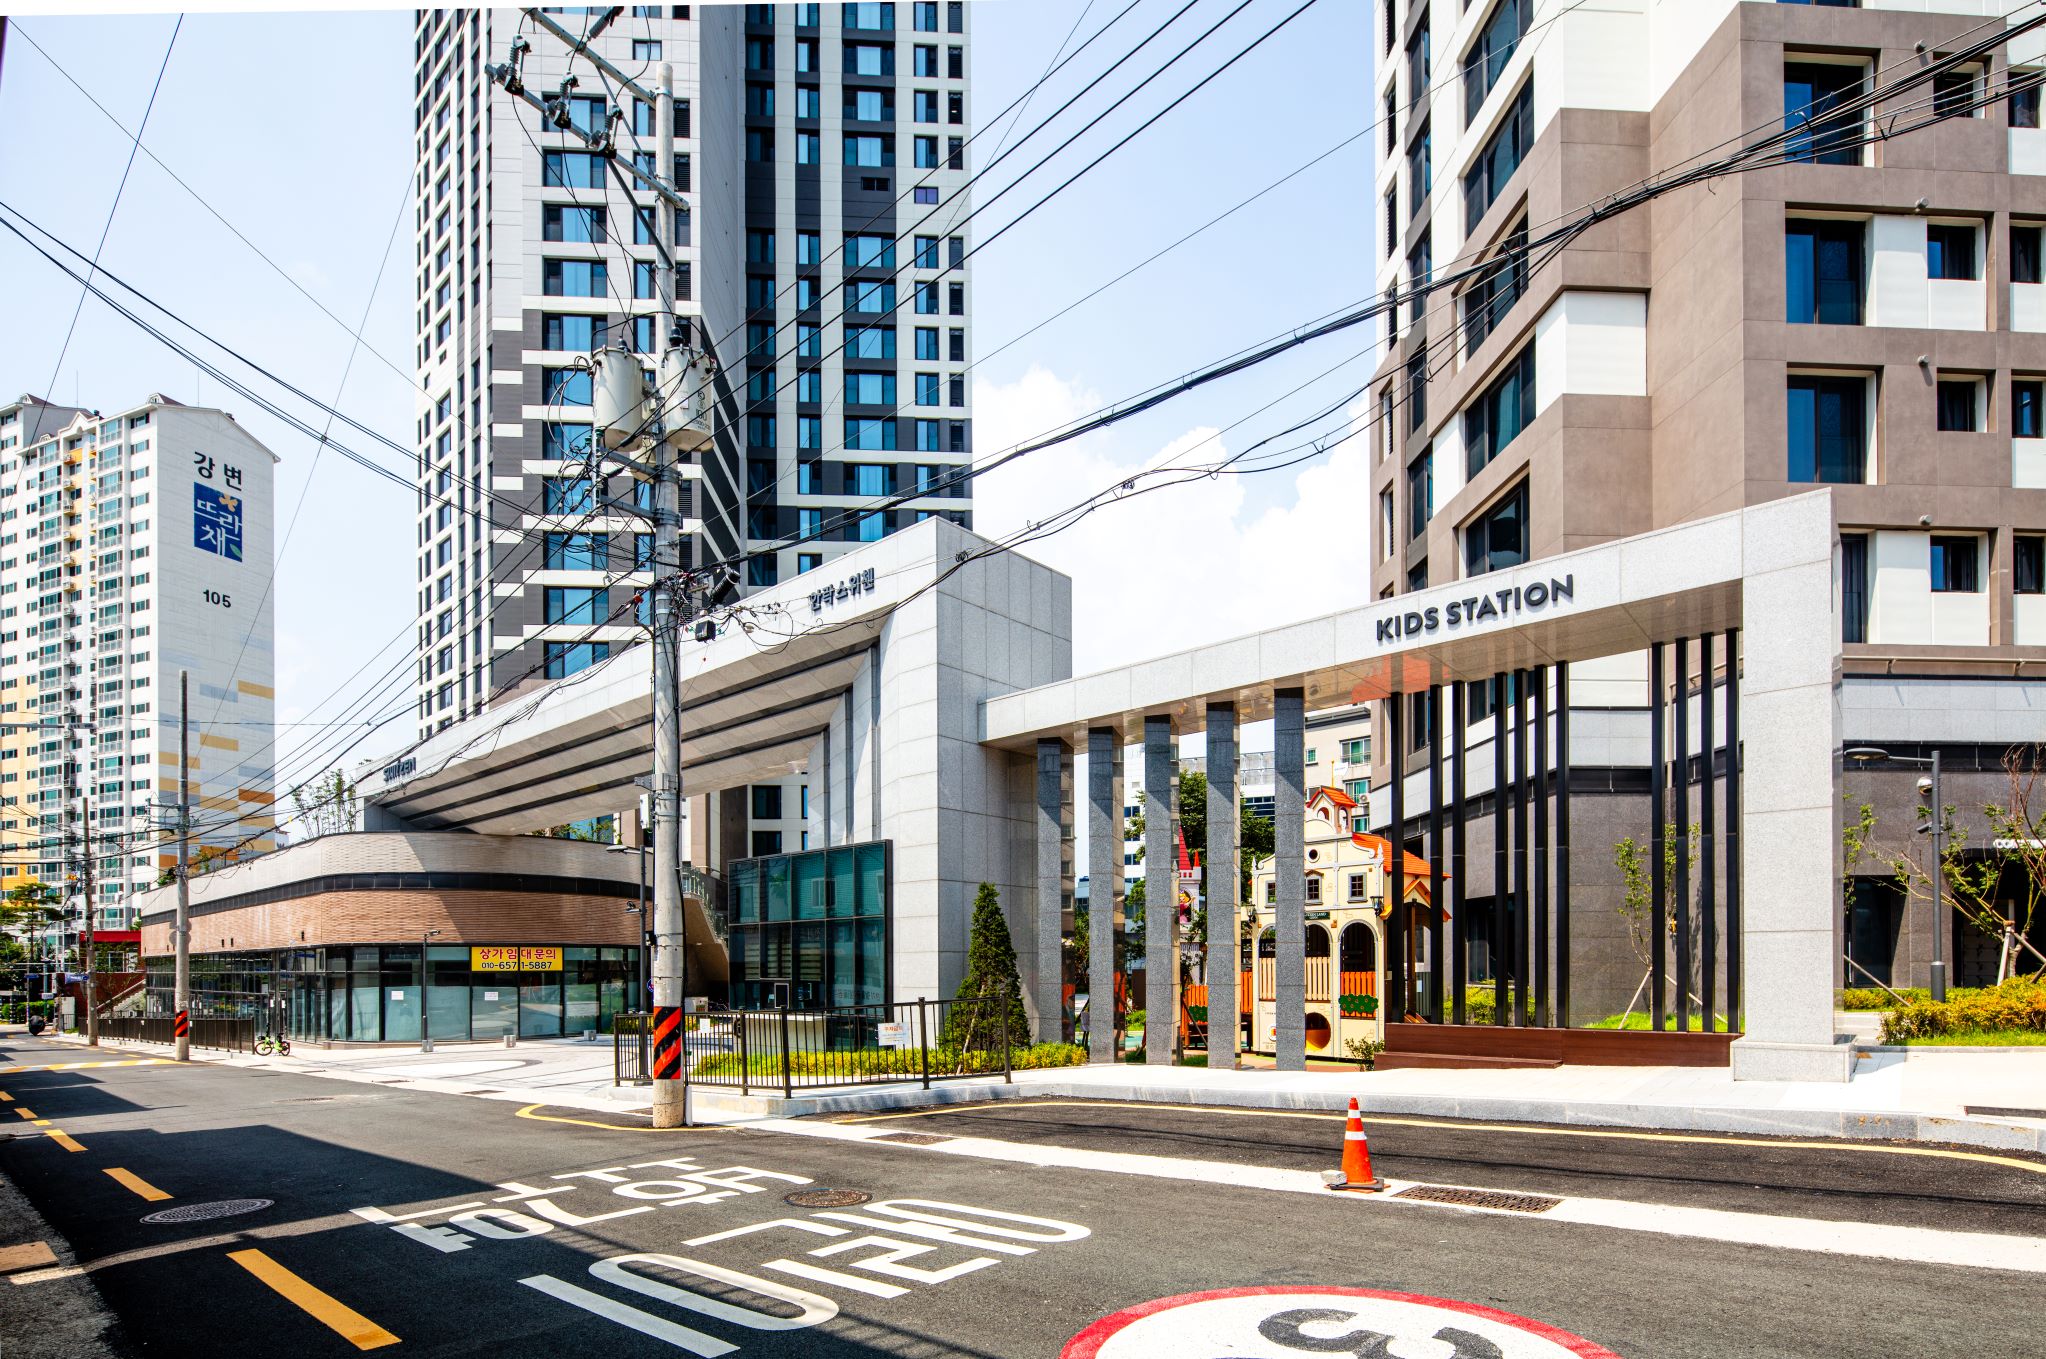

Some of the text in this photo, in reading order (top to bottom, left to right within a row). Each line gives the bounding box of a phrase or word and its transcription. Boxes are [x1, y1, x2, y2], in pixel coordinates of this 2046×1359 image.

[203, 589, 232, 608] 105
[1376, 574, 1574, 641] KIDS STATION
[480, 948, 557, 960] 상가 임대 문의
[481, 961, 553, 970] 010-6571-5887
[349, 1156, 815, 1253] 보호구역
[517, 1198, 1092, 1358] 어린이
